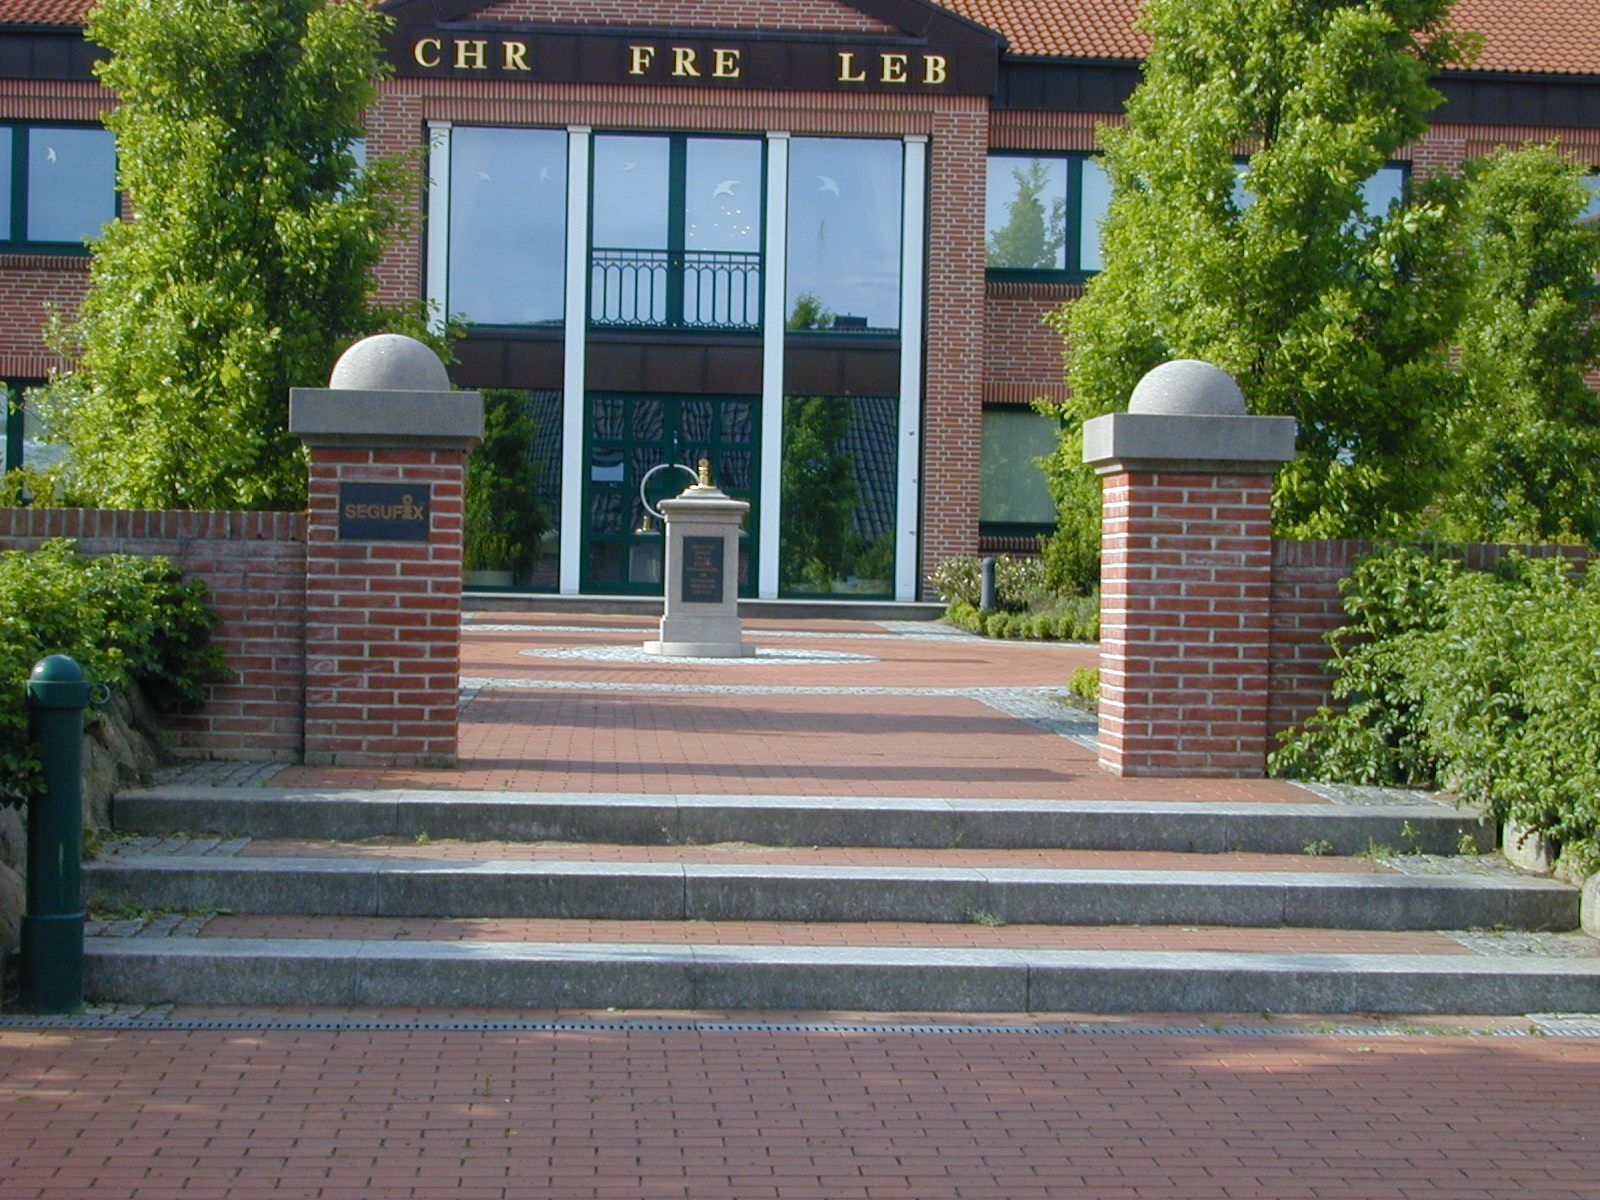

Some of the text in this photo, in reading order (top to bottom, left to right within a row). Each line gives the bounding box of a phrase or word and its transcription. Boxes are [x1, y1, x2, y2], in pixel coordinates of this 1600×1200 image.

[414, 38, 947, 84] CHR FRE LEB
[345, 495, 424, 520] SEGUFIX
